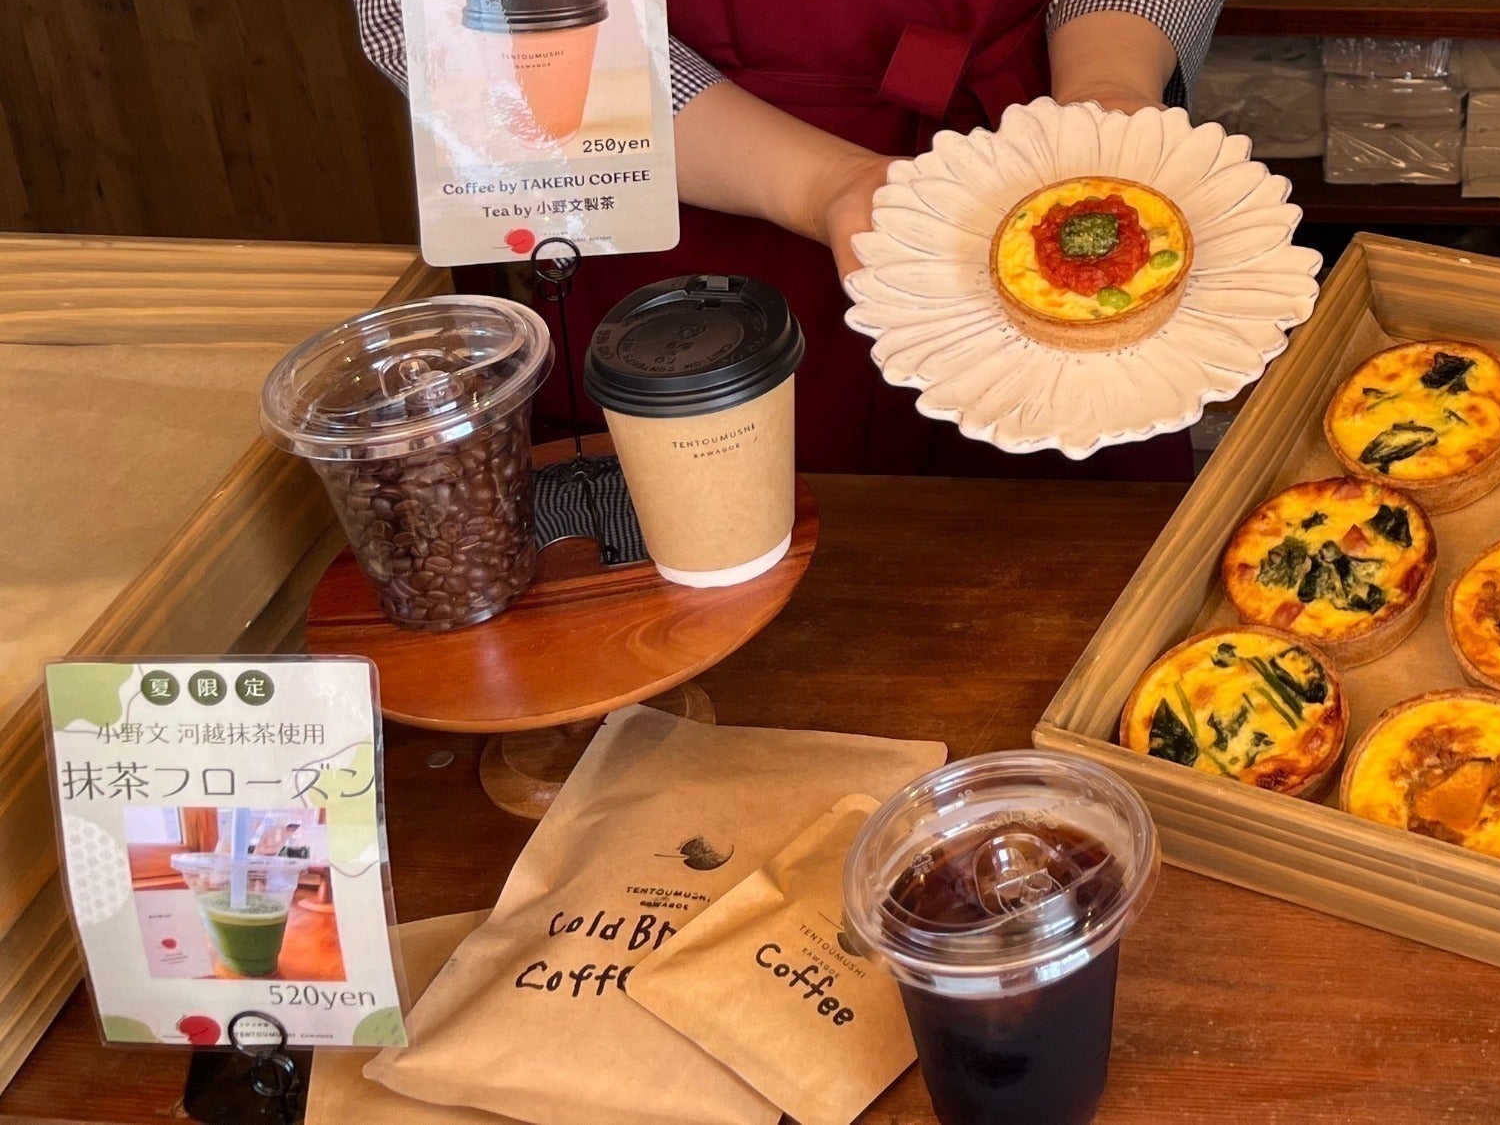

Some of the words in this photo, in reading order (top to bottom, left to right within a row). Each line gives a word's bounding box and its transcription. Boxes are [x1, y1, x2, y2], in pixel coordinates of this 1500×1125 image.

[583, 138, 651, 154] 250yen
[443, 181, 496, 196] Coffee
[499, 181, 518, 194] by
[523, 172, 585, 191] TAKERU
[589, 170, 651, 186] COFFEE
[482, 206, 510, 218] Tea
[514, 204, 532, 218] by
[536, 196, 615, 215] 小野文製茶
[671, 423, 756, 449] TENTOUMUSHI
[693, 443, 740, 459] KAWAGOE
[148, 677, 266, 698] 夏限定
[97, 722, 170, 746] 小野文
[177, 722, 326, 746] 河越抹茶使用
[61, 760, 376, 801] 抹茶フローズン
[626, 886, 712, 903] TENTOUMUSHI
[799, 923, 867, 979] TENTOUMUSHI
[756, 943, 855, 1025] Coffee
[268, 984, 376, 1011] 520yen
